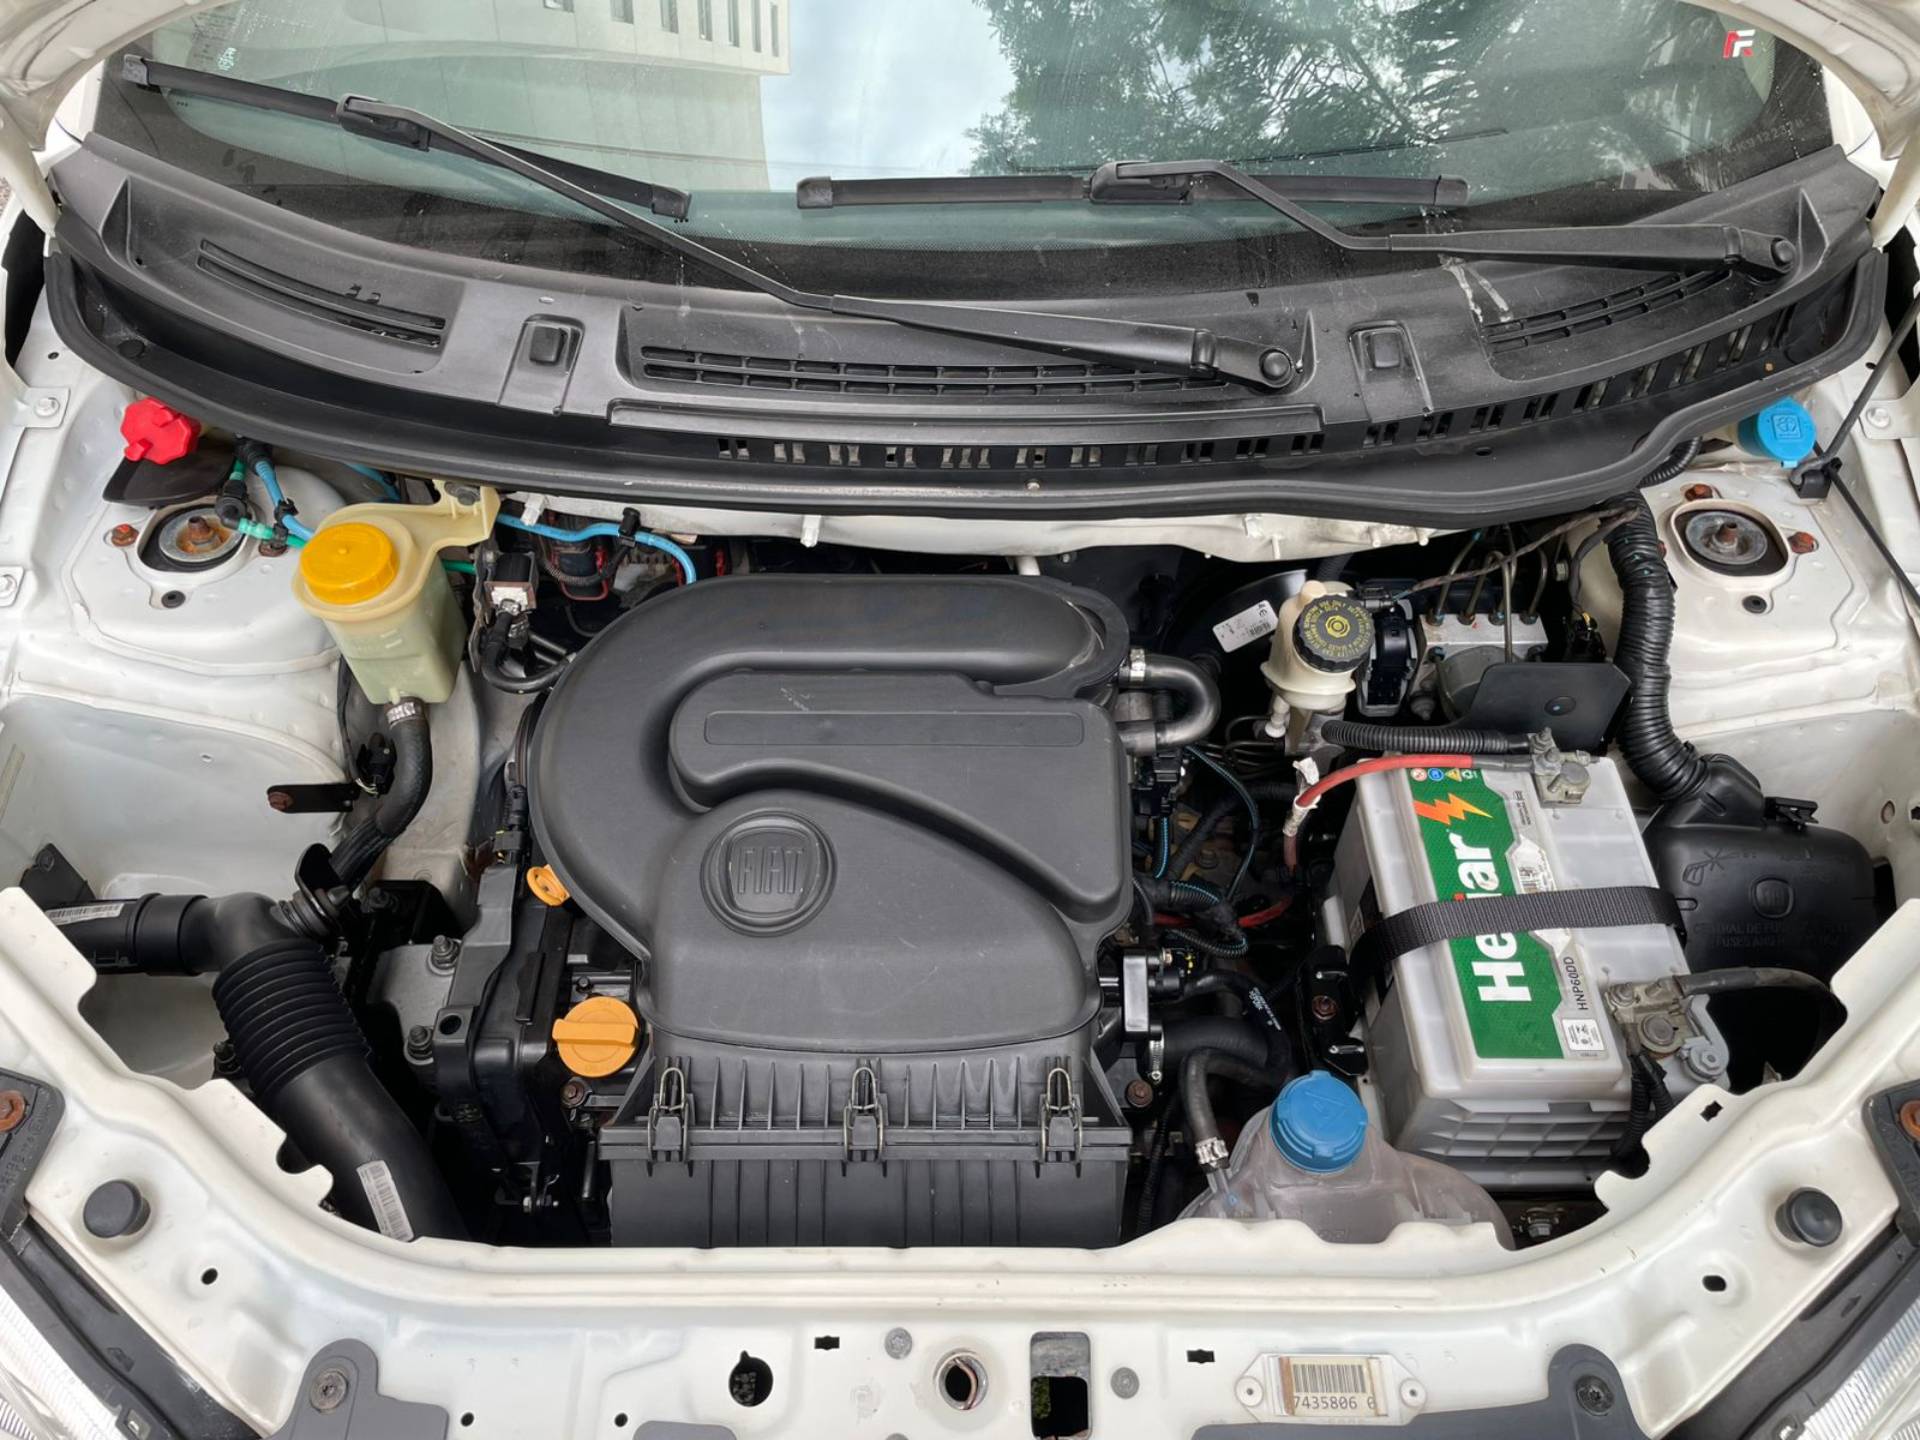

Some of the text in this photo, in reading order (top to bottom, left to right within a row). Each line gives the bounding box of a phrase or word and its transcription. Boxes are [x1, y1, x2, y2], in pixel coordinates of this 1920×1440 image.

[737, 847, 805, 895] FIAT
[1448, 832, 1532, 1002] Heiar
[1294, 1396, 1358, 1410] 7435806
